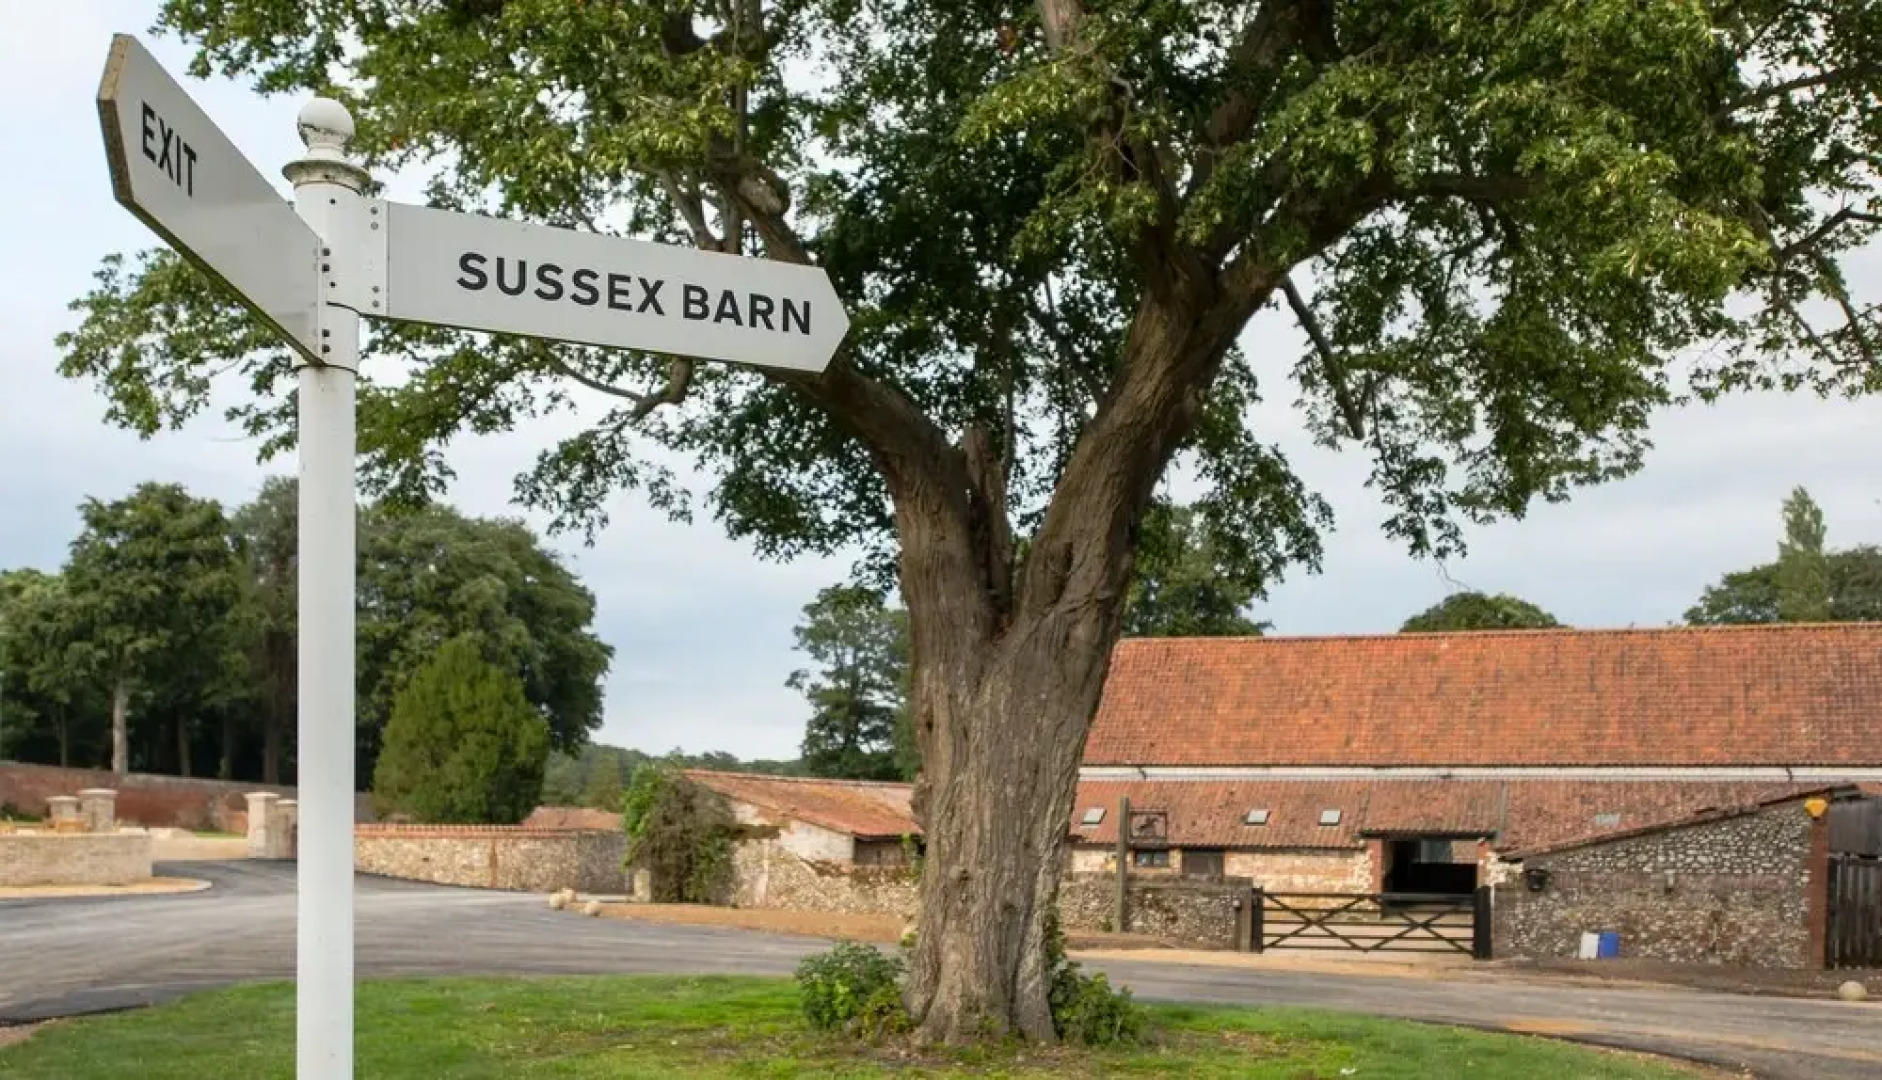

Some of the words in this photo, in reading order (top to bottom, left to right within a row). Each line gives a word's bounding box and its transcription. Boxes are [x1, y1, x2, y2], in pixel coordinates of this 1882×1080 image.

[142, 101, 197, 197] EXIT
[457, 251, 665, 316] SUSSEX
[682, 284, 811, 336] BARN
